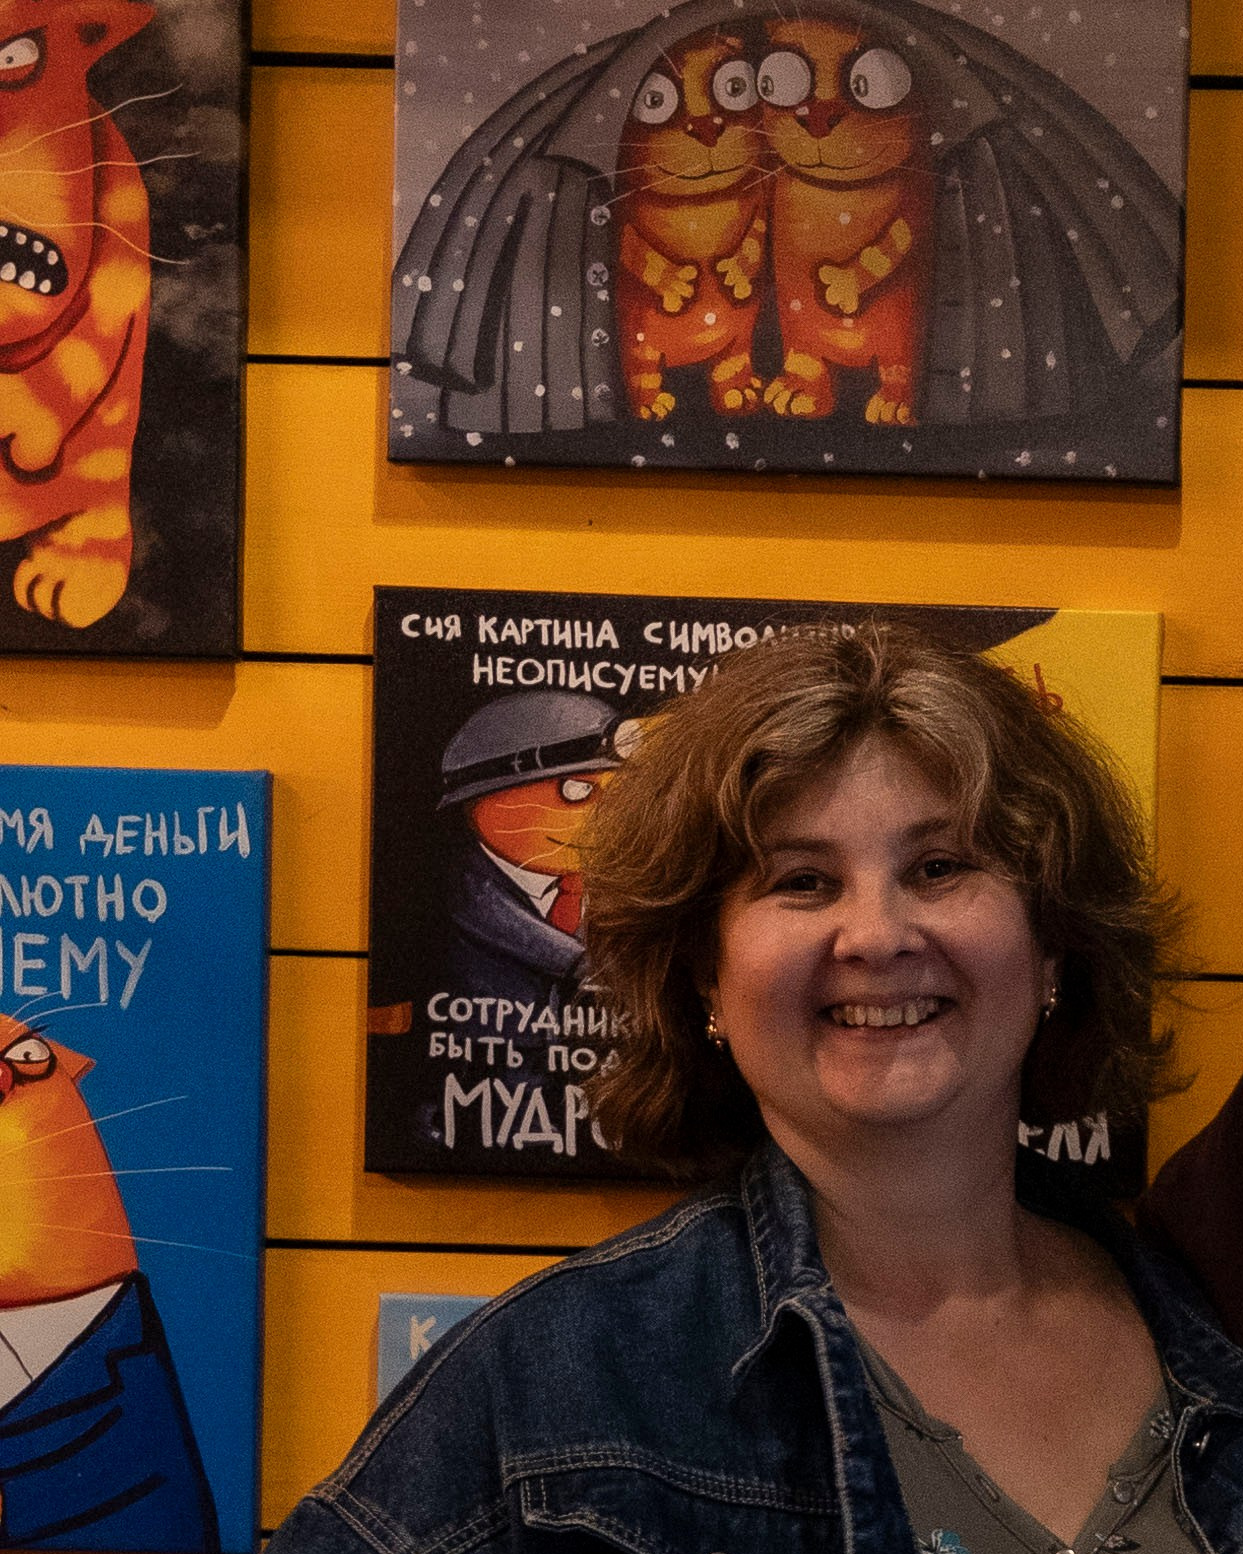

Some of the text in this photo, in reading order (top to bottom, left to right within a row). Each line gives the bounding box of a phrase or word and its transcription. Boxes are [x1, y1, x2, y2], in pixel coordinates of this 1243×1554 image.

[401, 613, 462, 641] СИЯ
[478, 614, 620, 650] КАРТИНА
[79, 801, 251, 859] ДЕНЬГИ
[0, 925, 153, 1011] ЕМУ
[429, 1032, 524, 1068] БЫТЬ
